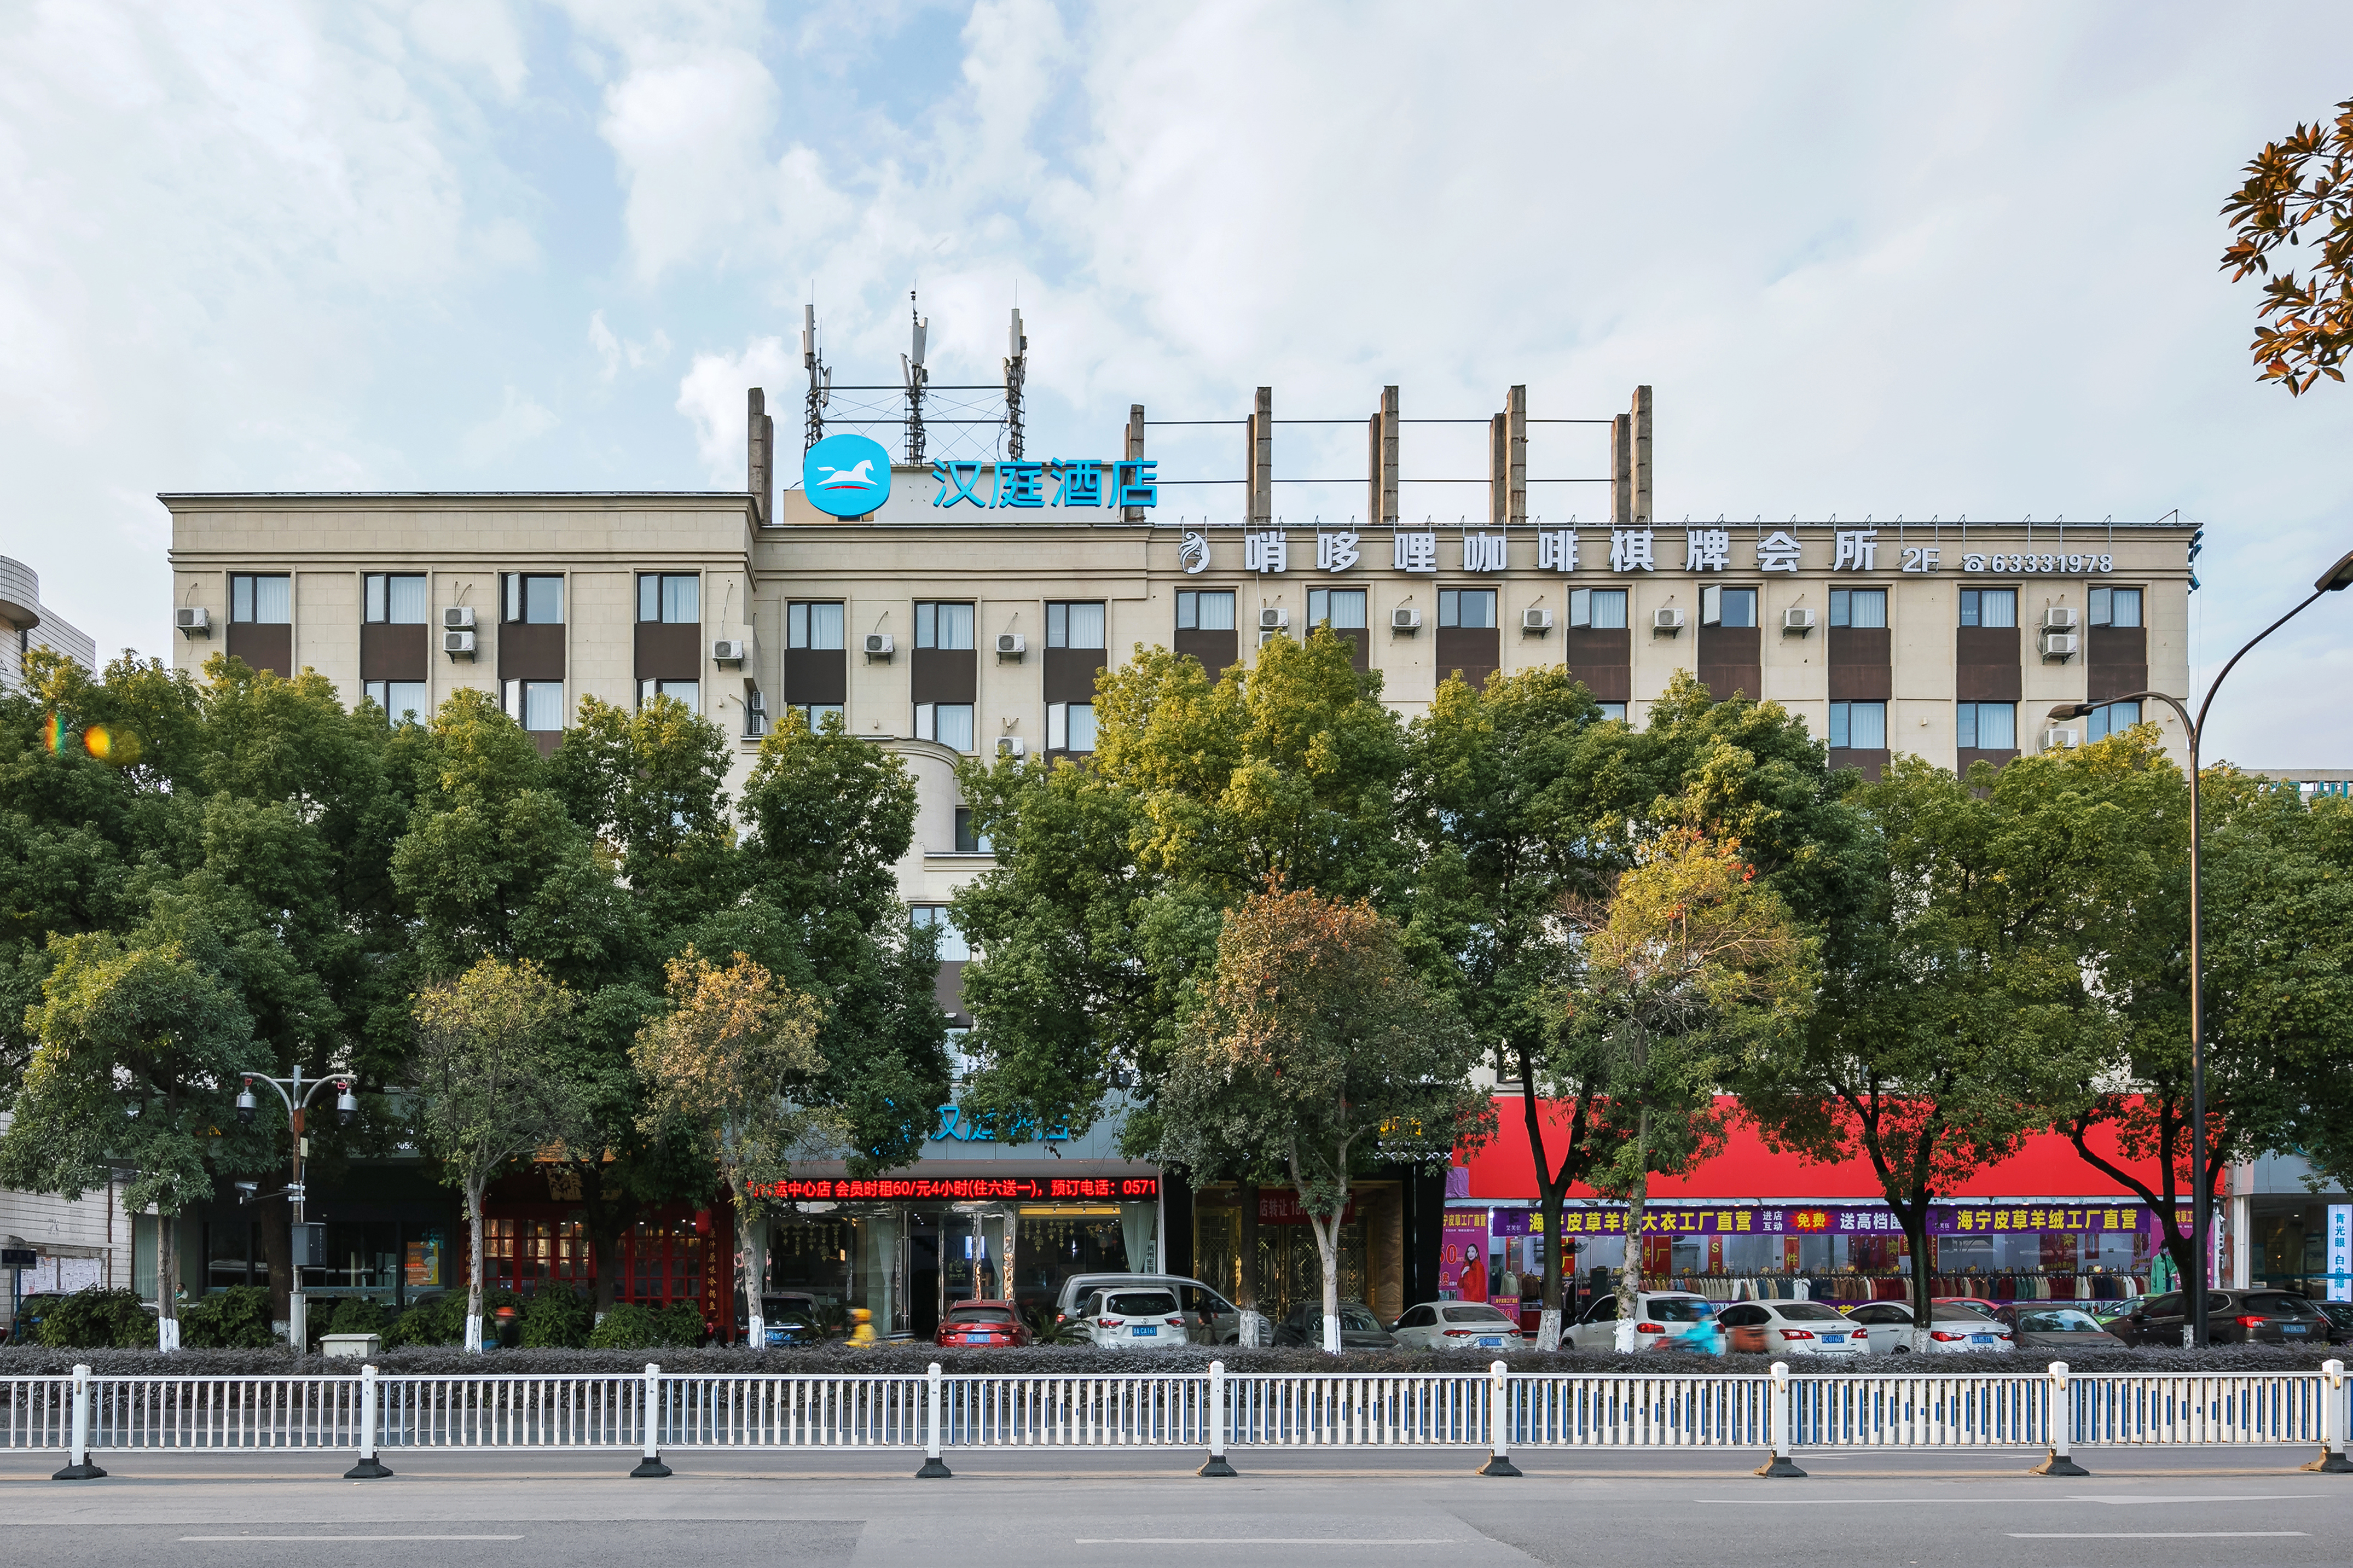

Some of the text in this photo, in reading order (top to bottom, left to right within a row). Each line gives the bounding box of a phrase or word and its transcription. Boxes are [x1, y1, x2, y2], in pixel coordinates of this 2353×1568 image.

[932, 457, 1158, 509] 汉庭酒店
[1244, 530, 2114, 573] 哨哆哩咖啡棋牌会所 2F 63331978
[747, 1180, 832, 1198] 运中心店
[1529, 1210, 1752, 1232] 海皮草羊大衣工厂直营
[1763, 1211, 1783, 1221] 进店
[1797, 1212, 1825, 1228] 免费
[1957, 1209, 2137, 1230] 海宁皮草羊绒工厂直营
[1763, 1222, 1783, 1232] 互动
[2334, 1213, 2345, 1247] 青光眼
